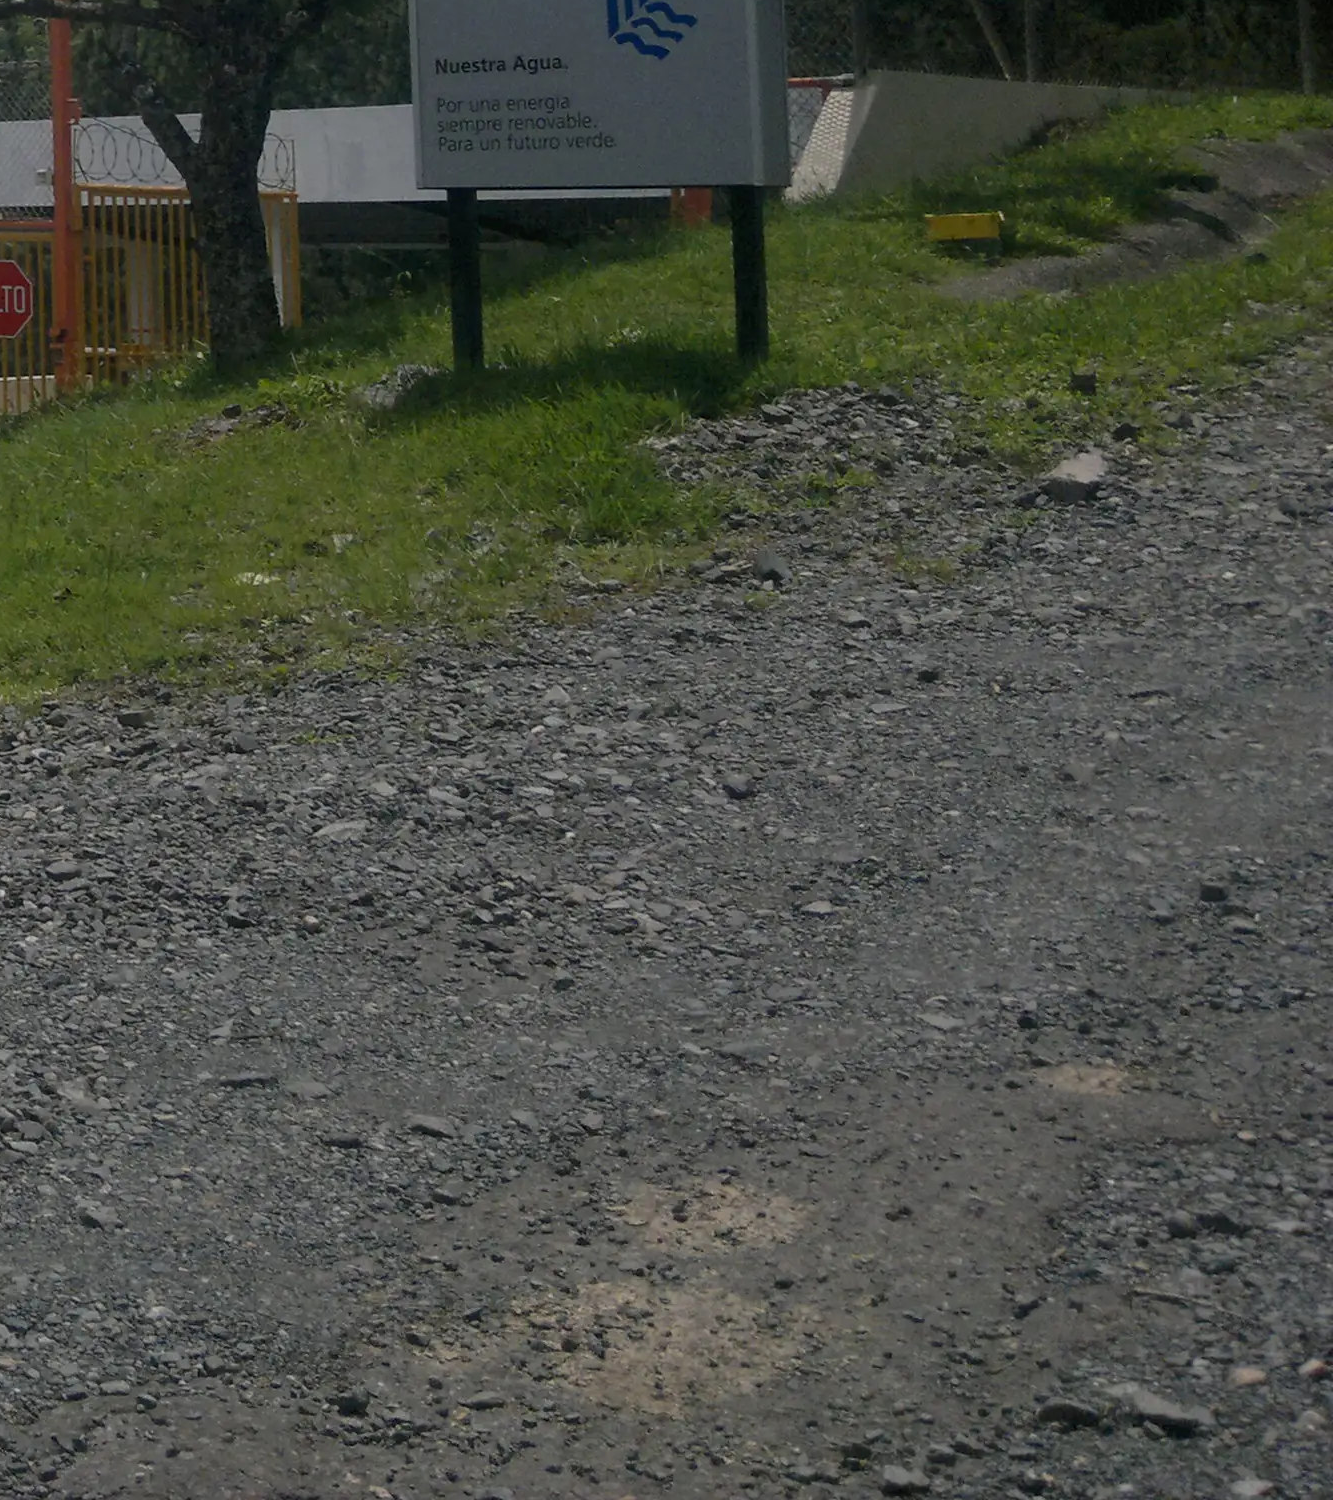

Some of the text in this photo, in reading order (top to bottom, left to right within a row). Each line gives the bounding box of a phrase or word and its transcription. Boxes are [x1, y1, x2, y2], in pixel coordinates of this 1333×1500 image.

[435, 56, 569, 75] Nuestra Agua.
[436, 97, 463, 114] Por
[468, 99, 501, 113] una
[437, 112, 597, 135] siempre renovable.
[438, 131, 617, 152] Para un futuro verde.
